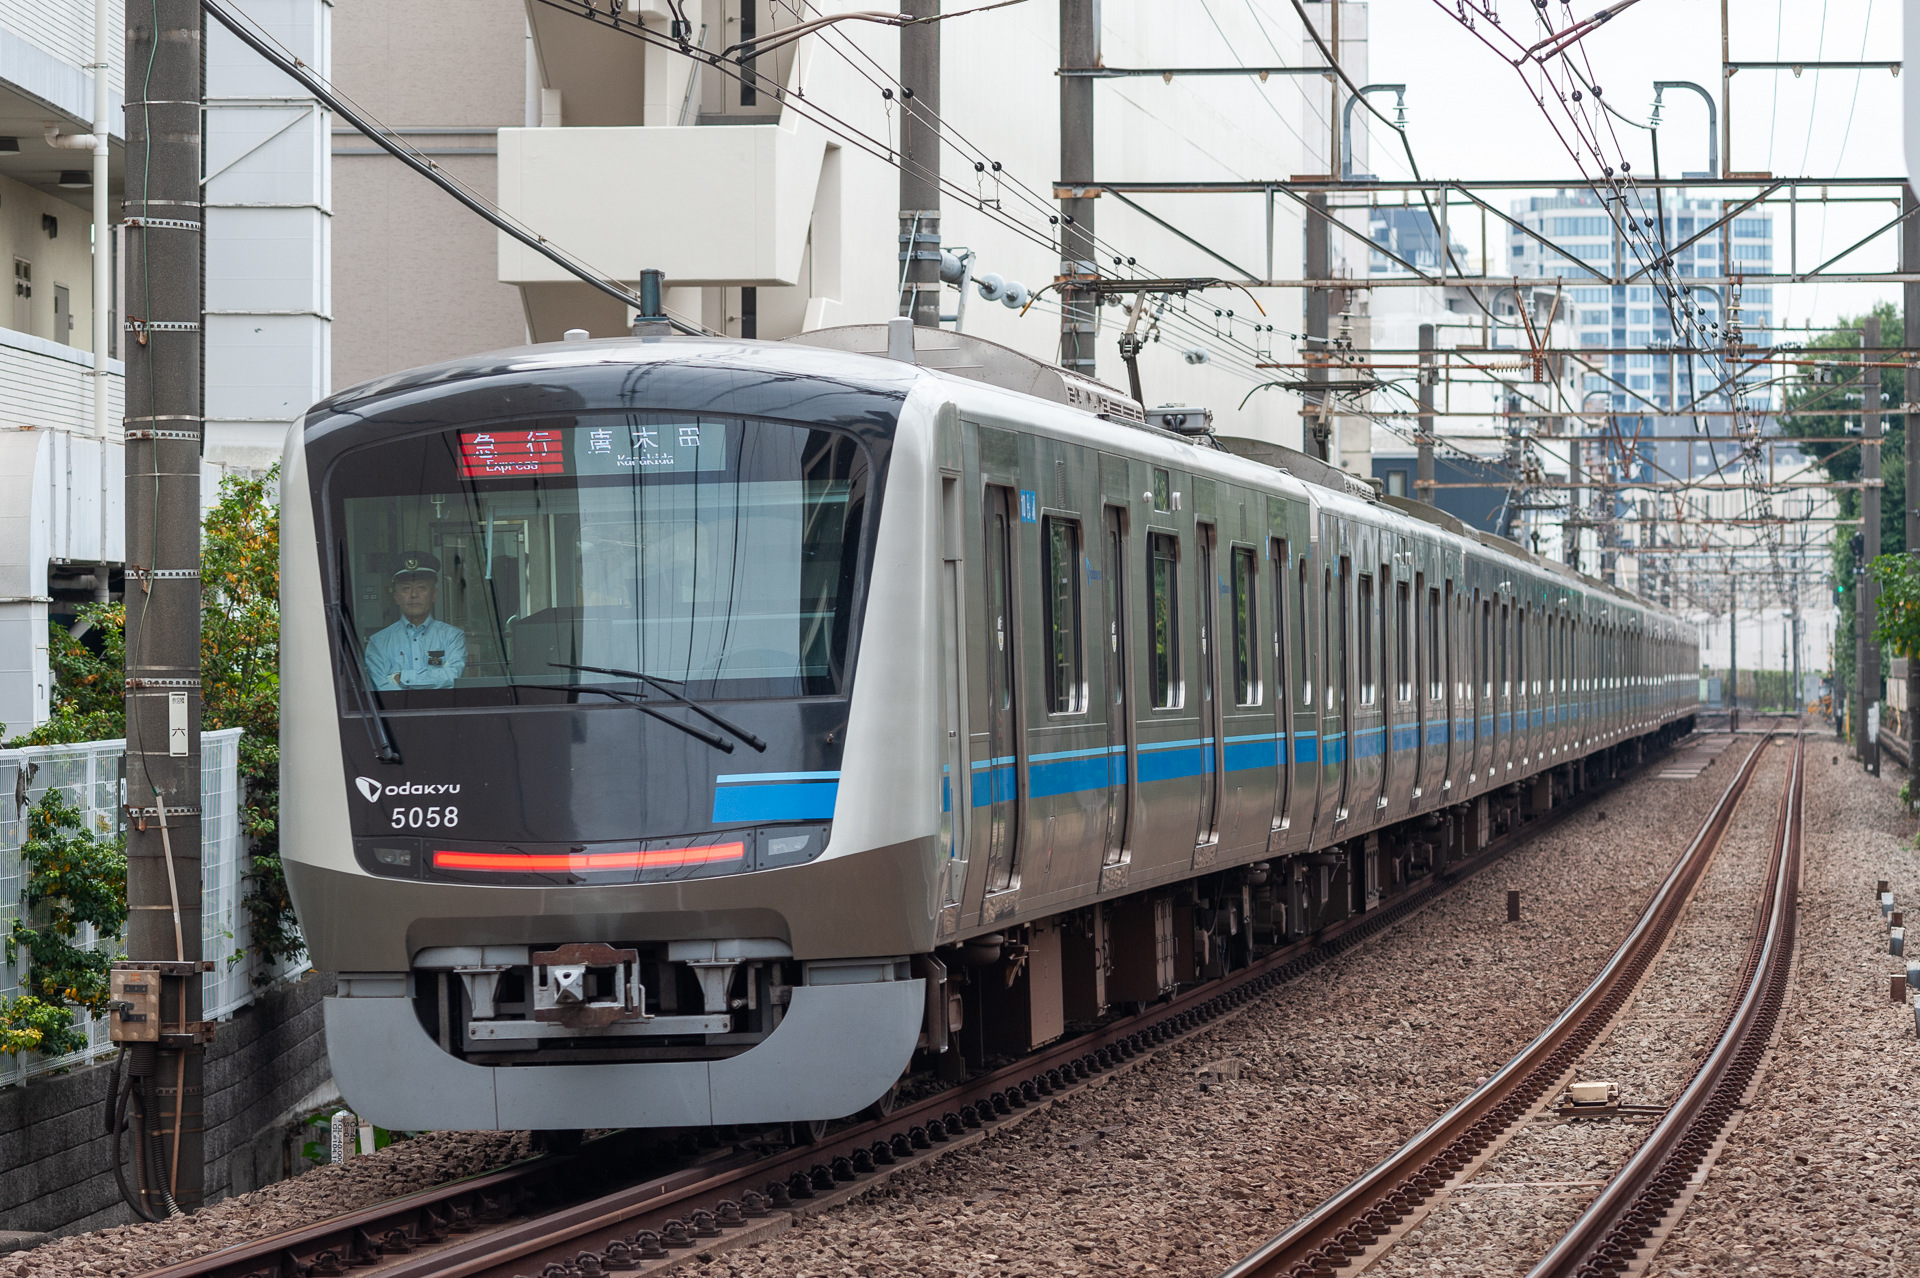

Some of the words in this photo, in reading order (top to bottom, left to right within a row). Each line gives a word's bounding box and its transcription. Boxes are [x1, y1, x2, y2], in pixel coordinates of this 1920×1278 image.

[473, 431, 552, 458] 急行
[588, 427, 700, 454] 唐木田
[486, 459, 539, 473] Express
[616, 452, 674, 466] Karakida
[385, 781, 461, 796] odakyu
[391, 806, 459, 829] 5058
